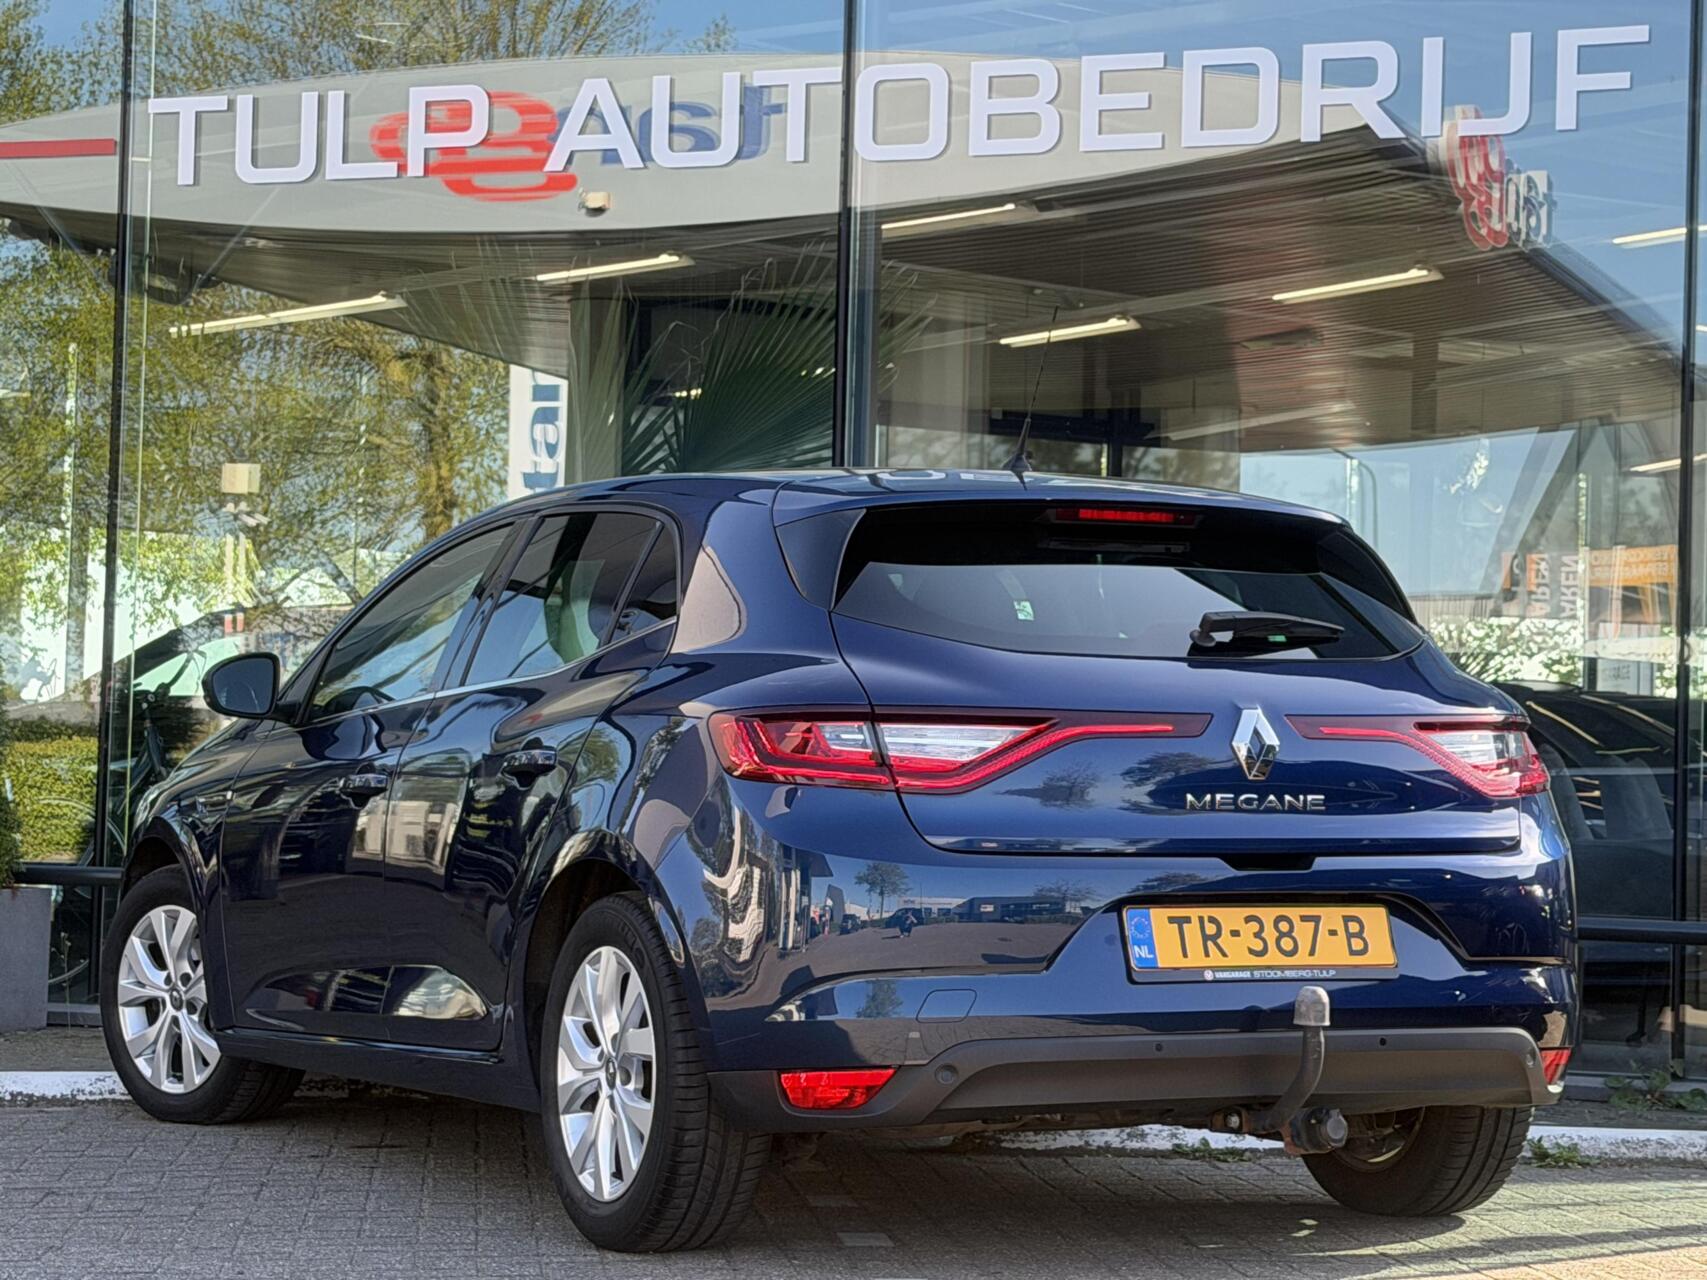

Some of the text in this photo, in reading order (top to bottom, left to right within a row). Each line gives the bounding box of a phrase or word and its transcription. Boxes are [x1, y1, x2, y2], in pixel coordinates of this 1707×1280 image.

[147, 25, 1650, 187] TULP AUTOBEDRIJF
[1185, 792, 1327, 811] MEGANE
[1134, 944, 1154, 959] NL
[1167, 914, 1370, 959] TR-387-B
